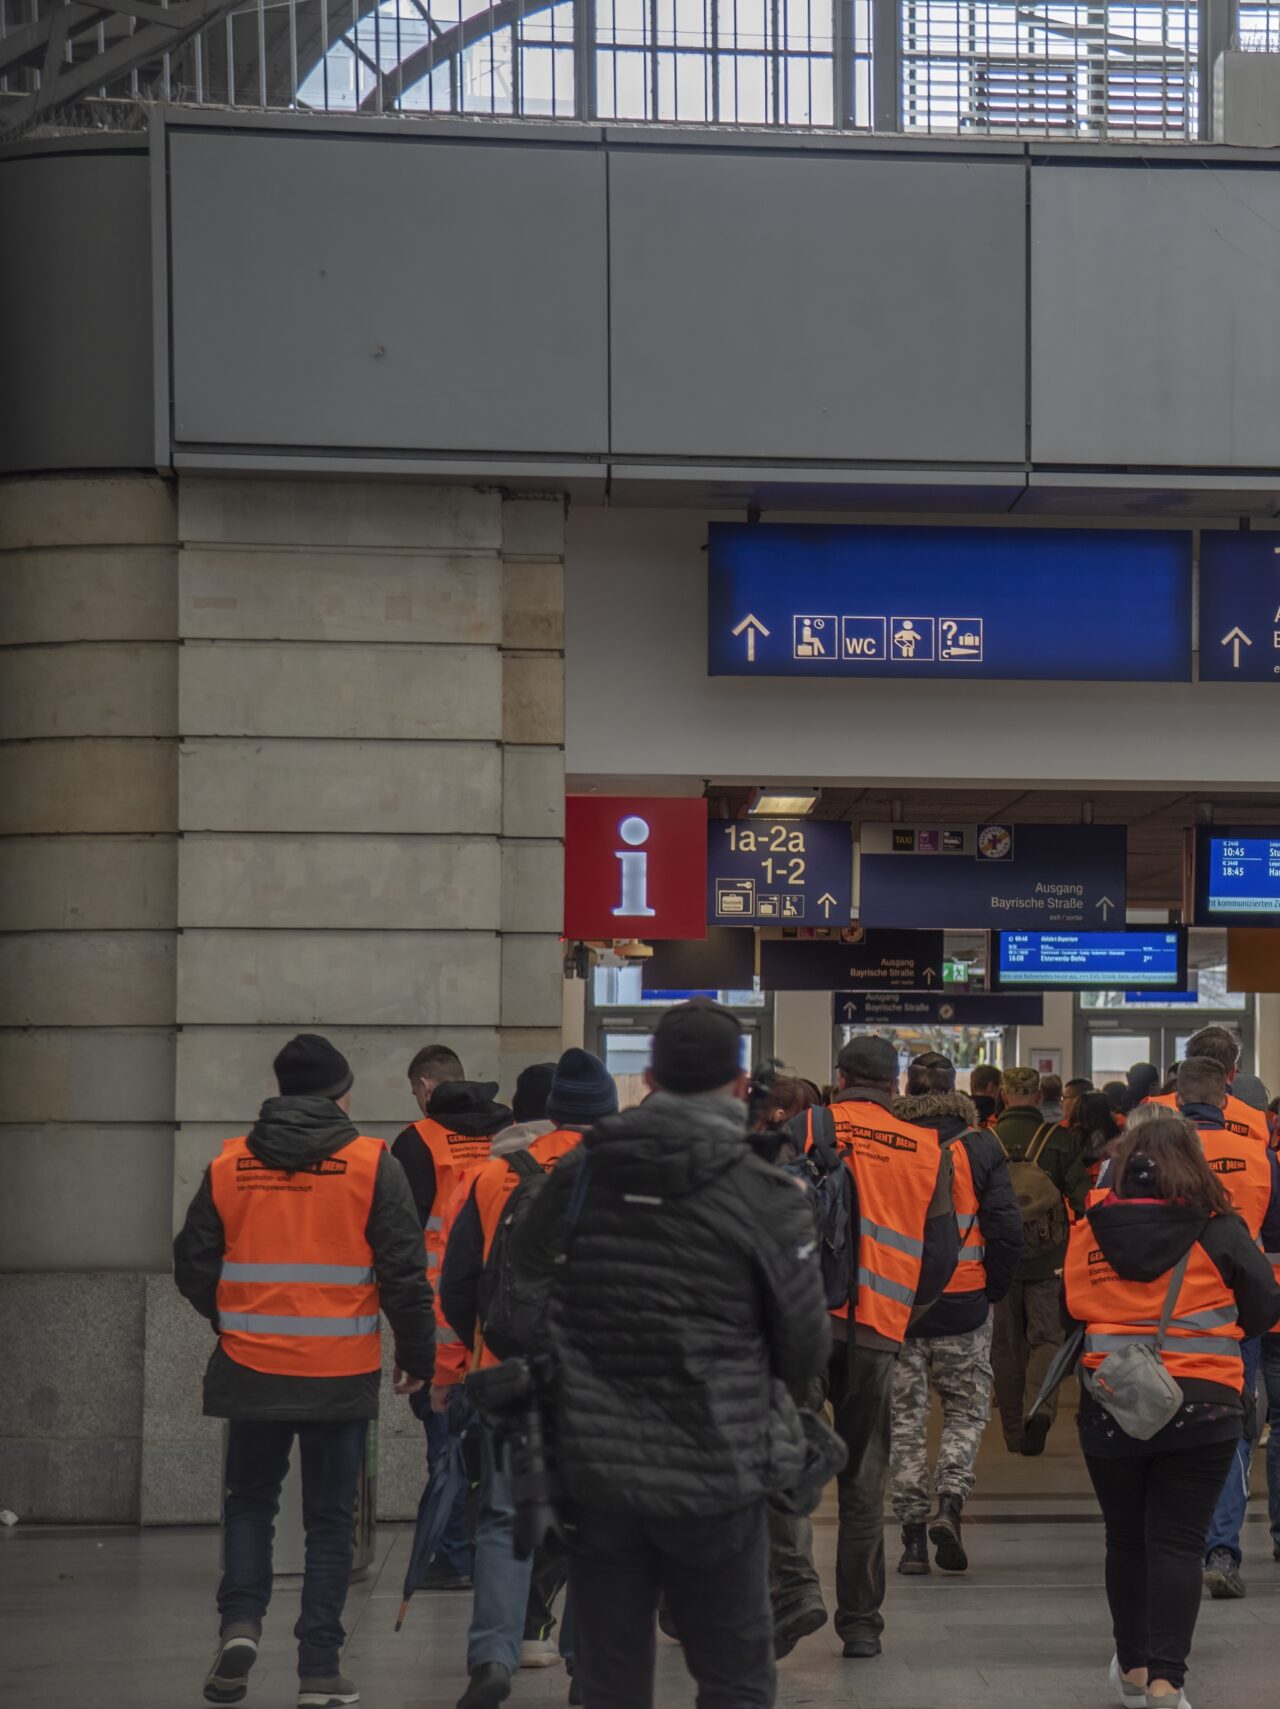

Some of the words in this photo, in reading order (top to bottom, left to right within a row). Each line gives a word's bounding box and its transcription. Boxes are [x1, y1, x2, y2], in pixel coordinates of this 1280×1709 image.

[845, 637, 877, 655] WC
[725, 825, 806, 852] 1a-2a
[895, 836, 913, 845] TAXI
[1223, 848, 1245, 857] 10:45
[761, 858, 806, 885] 1-2
[1222, 867, 1244, 877] 18:45
[1035, 882, 1083, 895] Ausgang
[991, 896, 1044, 910] Bayrische
[1047, 897, 1083, 909] Straße
[1217, 899, 1273, 908] kommunizierten
[881, 958, 914, 968] Ausgang
[850, 967, 887, 978] Bayrische
[889, 968, 914, 977] Straße
